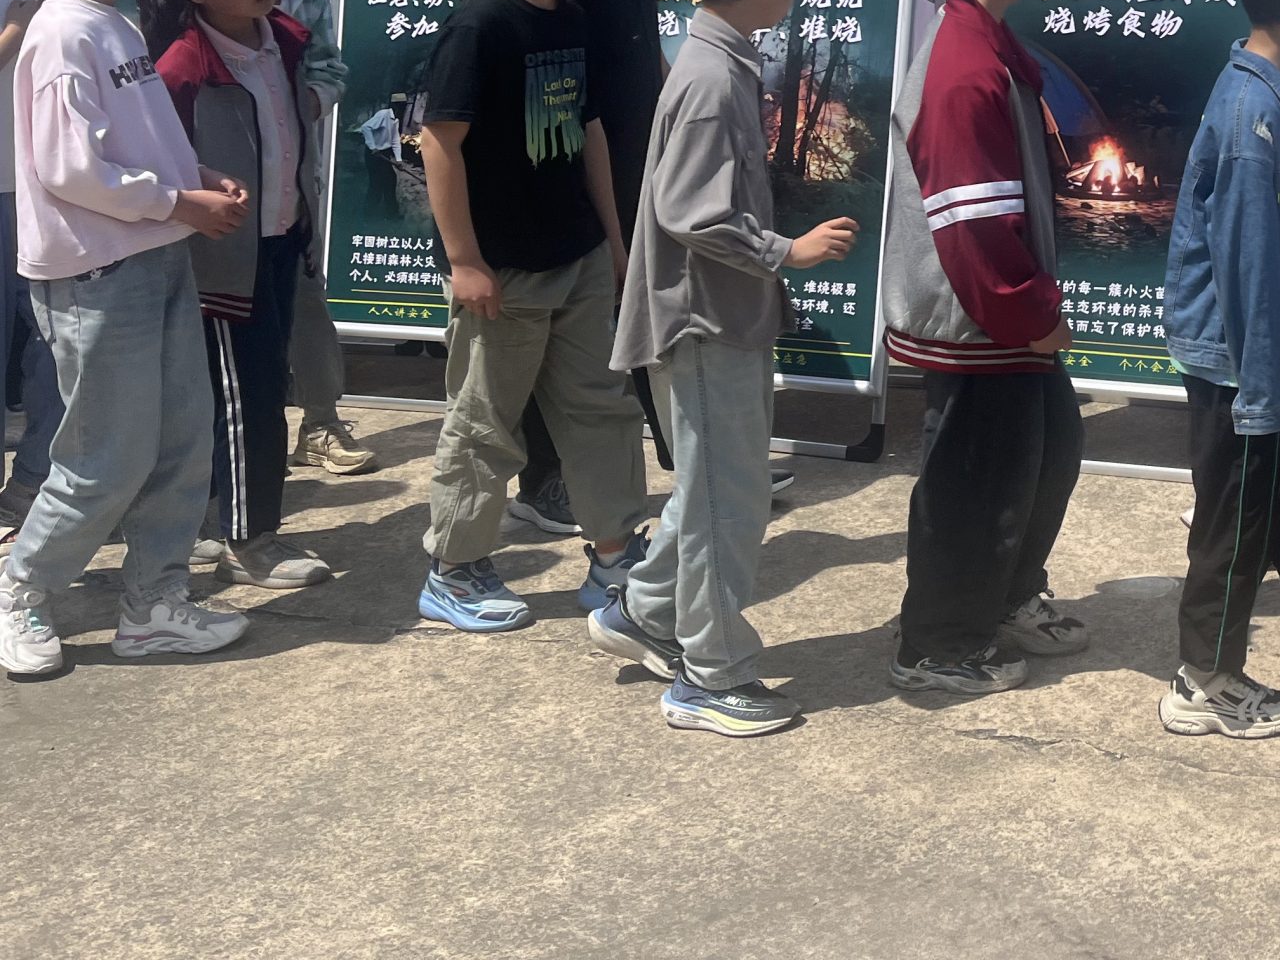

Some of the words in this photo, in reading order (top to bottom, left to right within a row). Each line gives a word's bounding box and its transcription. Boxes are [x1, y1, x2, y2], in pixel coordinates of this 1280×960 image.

[386, 12, 439, 40] 参加
[1043, 6, 1183, 39] 烧烤食物
[1056, 279, 1165, 300] 的每一簇小火苗
[368, 306, 432, 319] 人人讲安全
[1063, 354, 1093, 368] 安全
